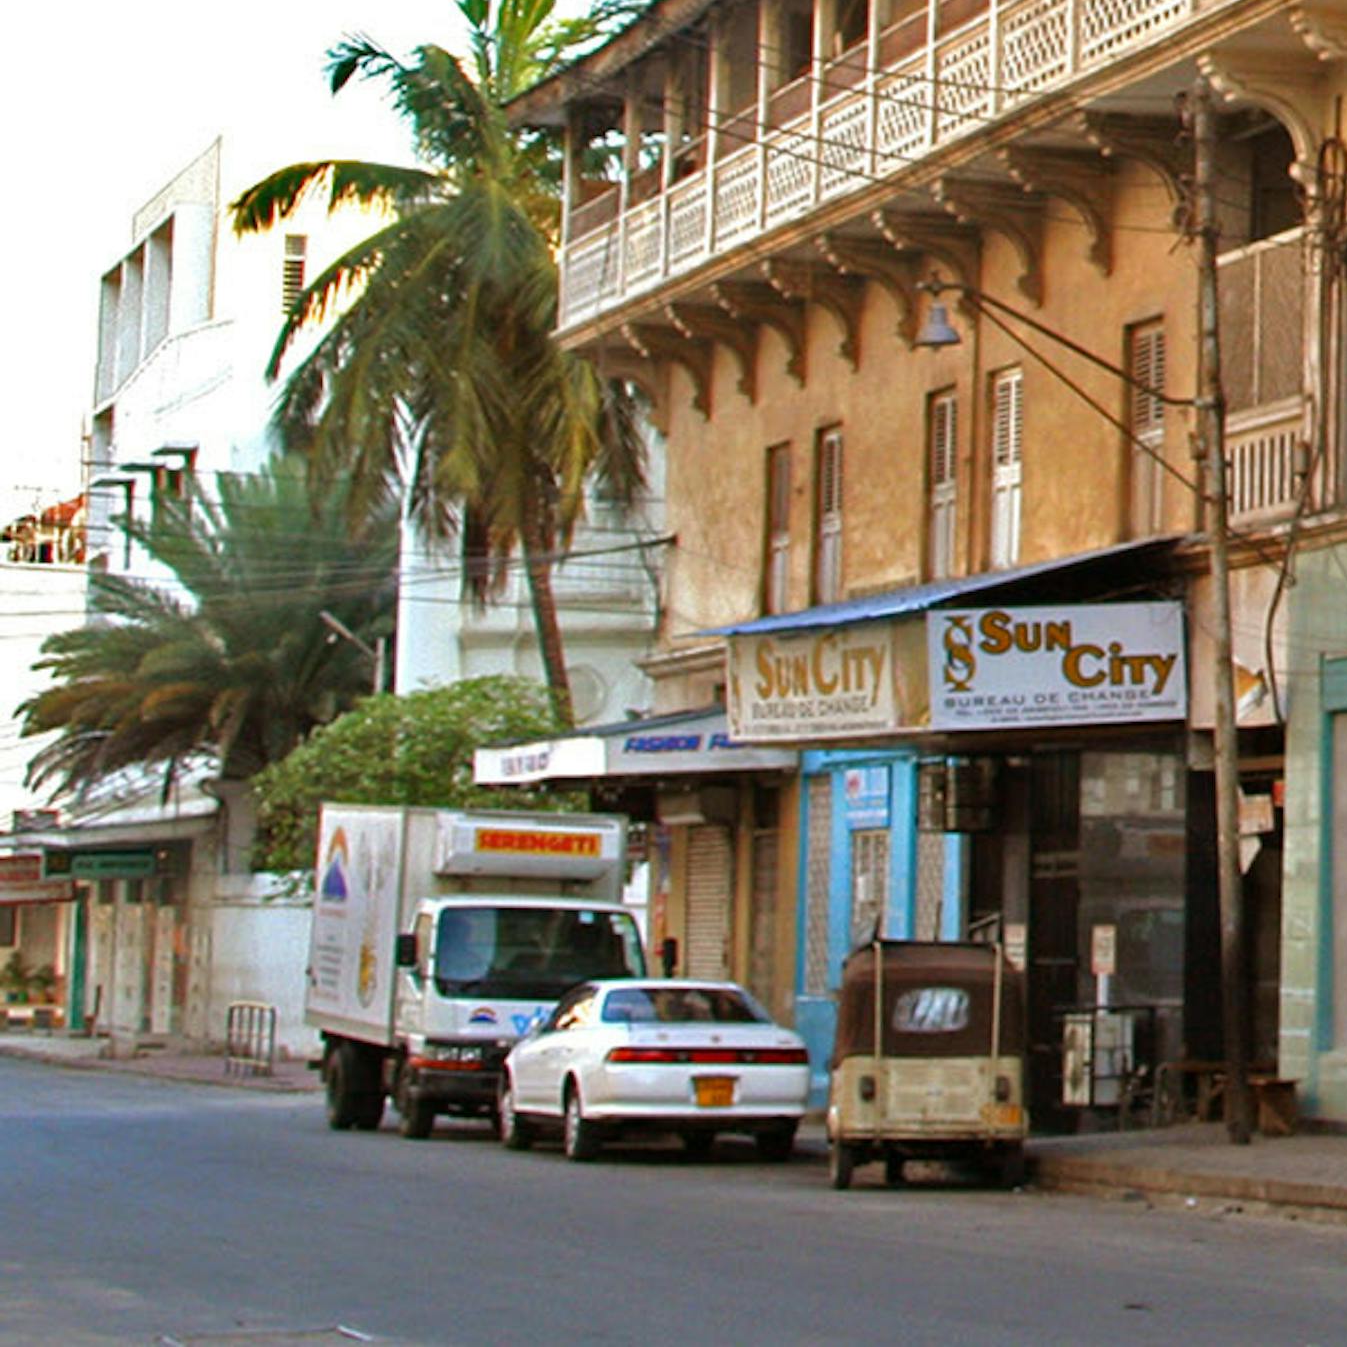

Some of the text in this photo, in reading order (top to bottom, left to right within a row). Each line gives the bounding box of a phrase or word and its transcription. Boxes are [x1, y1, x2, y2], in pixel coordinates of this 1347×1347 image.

[944, 692, 1026, 709] BUREAU
[1034, 691, 1059, 704] DE
[1068, 689, 1150, 703] CHANGE
